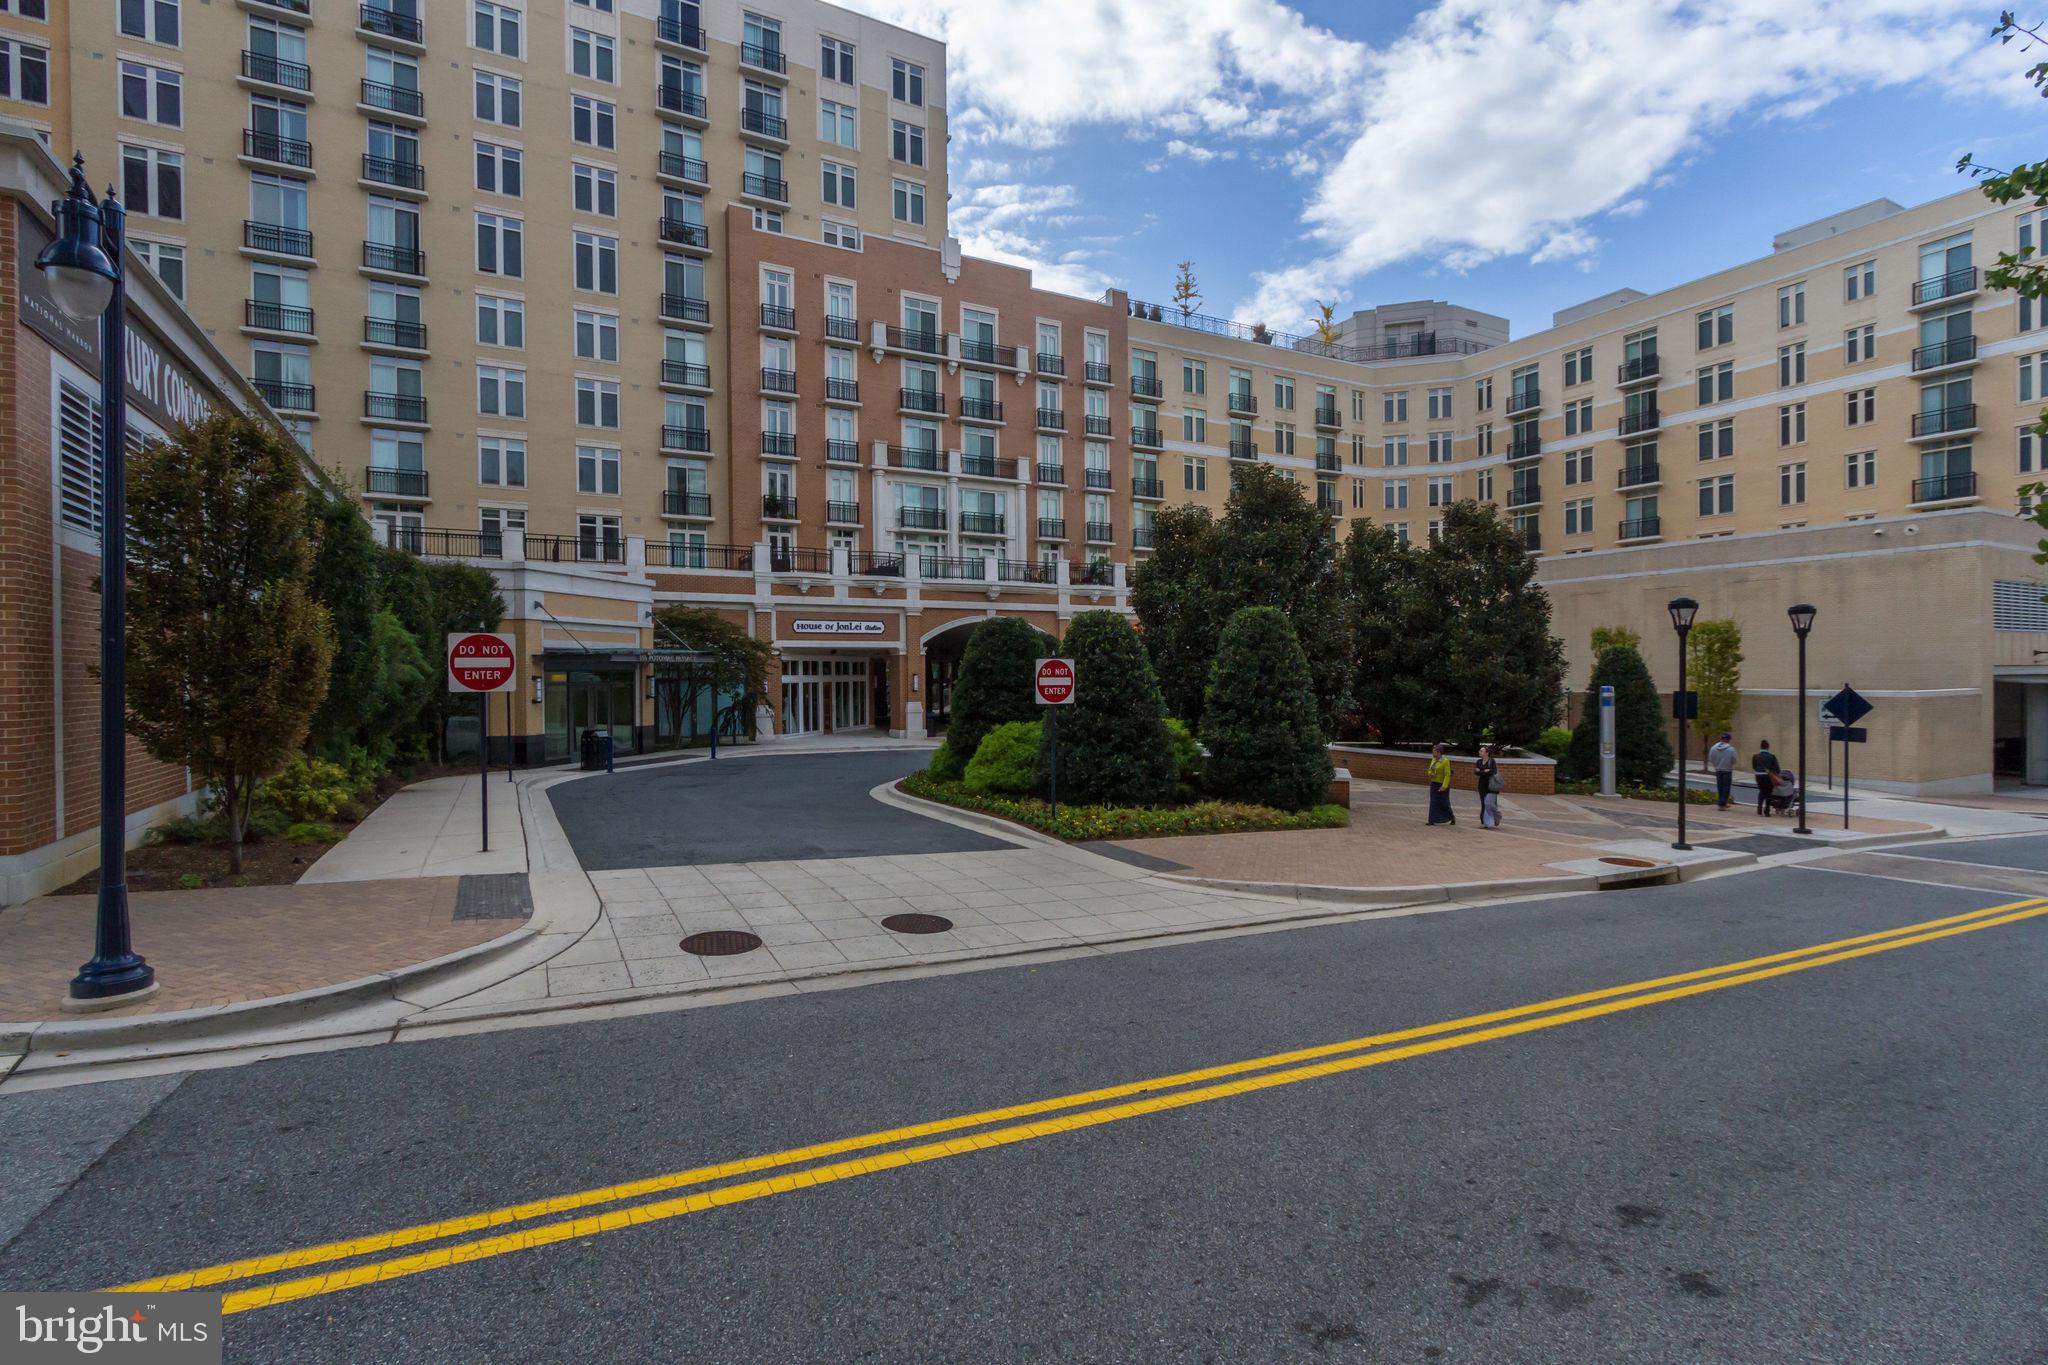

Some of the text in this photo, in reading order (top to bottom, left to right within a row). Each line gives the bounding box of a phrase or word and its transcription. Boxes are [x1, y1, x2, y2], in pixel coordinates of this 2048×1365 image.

[24, 295, 92, 354] NATIONAL HARBOR
[459, 645, 504, 655] DO NOT
[464, 670, 501, 680] ENTER
[1044, 687, 1066, 695] ENTER
